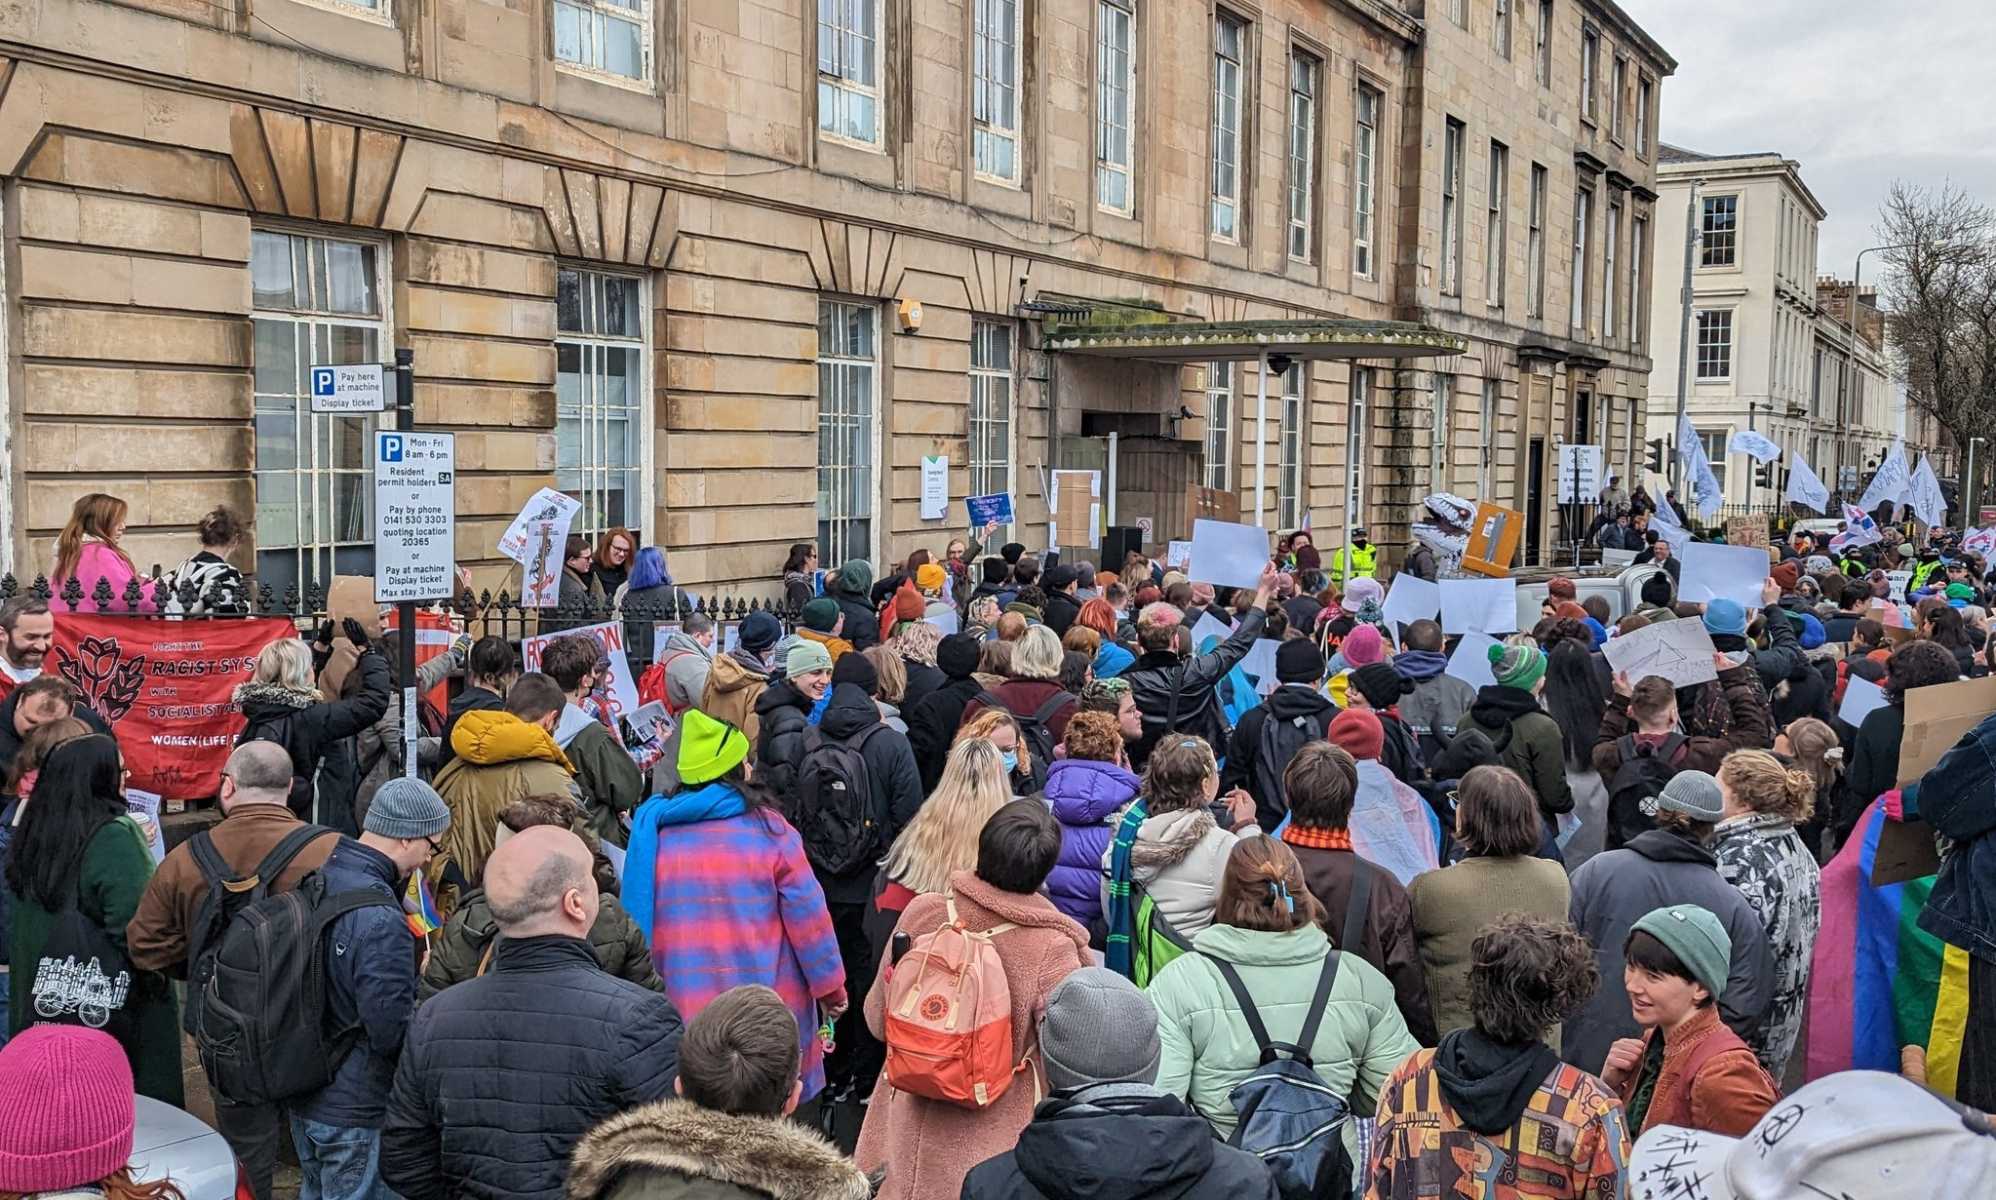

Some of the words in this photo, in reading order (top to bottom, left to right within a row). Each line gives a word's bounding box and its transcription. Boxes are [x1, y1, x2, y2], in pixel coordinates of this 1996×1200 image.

[319, 372, 332, 393] P
[341, 372, 355, 383] Pay
[358, 372, 376, 381] here
[336, 383, 345, 392] at
[347, 382, 380, 392] machine
[321, 399, 350, 408] Display
[352, 399, 375, 407] ticket
[410, 438, 427, 447] Mon
[433, 439, 444, 447] Fri
[386, 438, 400, 460] P
[390, 467, 424, 476] Resident
[378, 478, 405, 487] permit
[407, 478, 436, 487] holders
[439, 472, 451, 483] SA
[389, 506, 404, 515] Pay
[406, 506, 415, 515] by
[418, 506, 442, 515] phone
[384, 516, 403, 525] 0141
[405, 516, 422, 524] 530
[424, 515, 447, 524] 3303
[383, 528, 414, 537] quoting
[416, 527, 447, 536] location
[402, 537, 430, 547] 20365
[385, 566, 400, 575] Pay
[402, 566, 411, 574] at
[412, 563, 445, 573] machine
[389, 576, 417, 586] Display
[420, 575, 442, 584] ticket
[381, 589, 398, 597] Max
[400, 588, 417, 597] stay
[419, 587, 425, 595] 3
[427, 586, 449, 595] hours
[152, 660, 217, 677] RACIST
[220, 656, 260, 674] SYS
[148, 702, 225, 718] SOCIALIST
